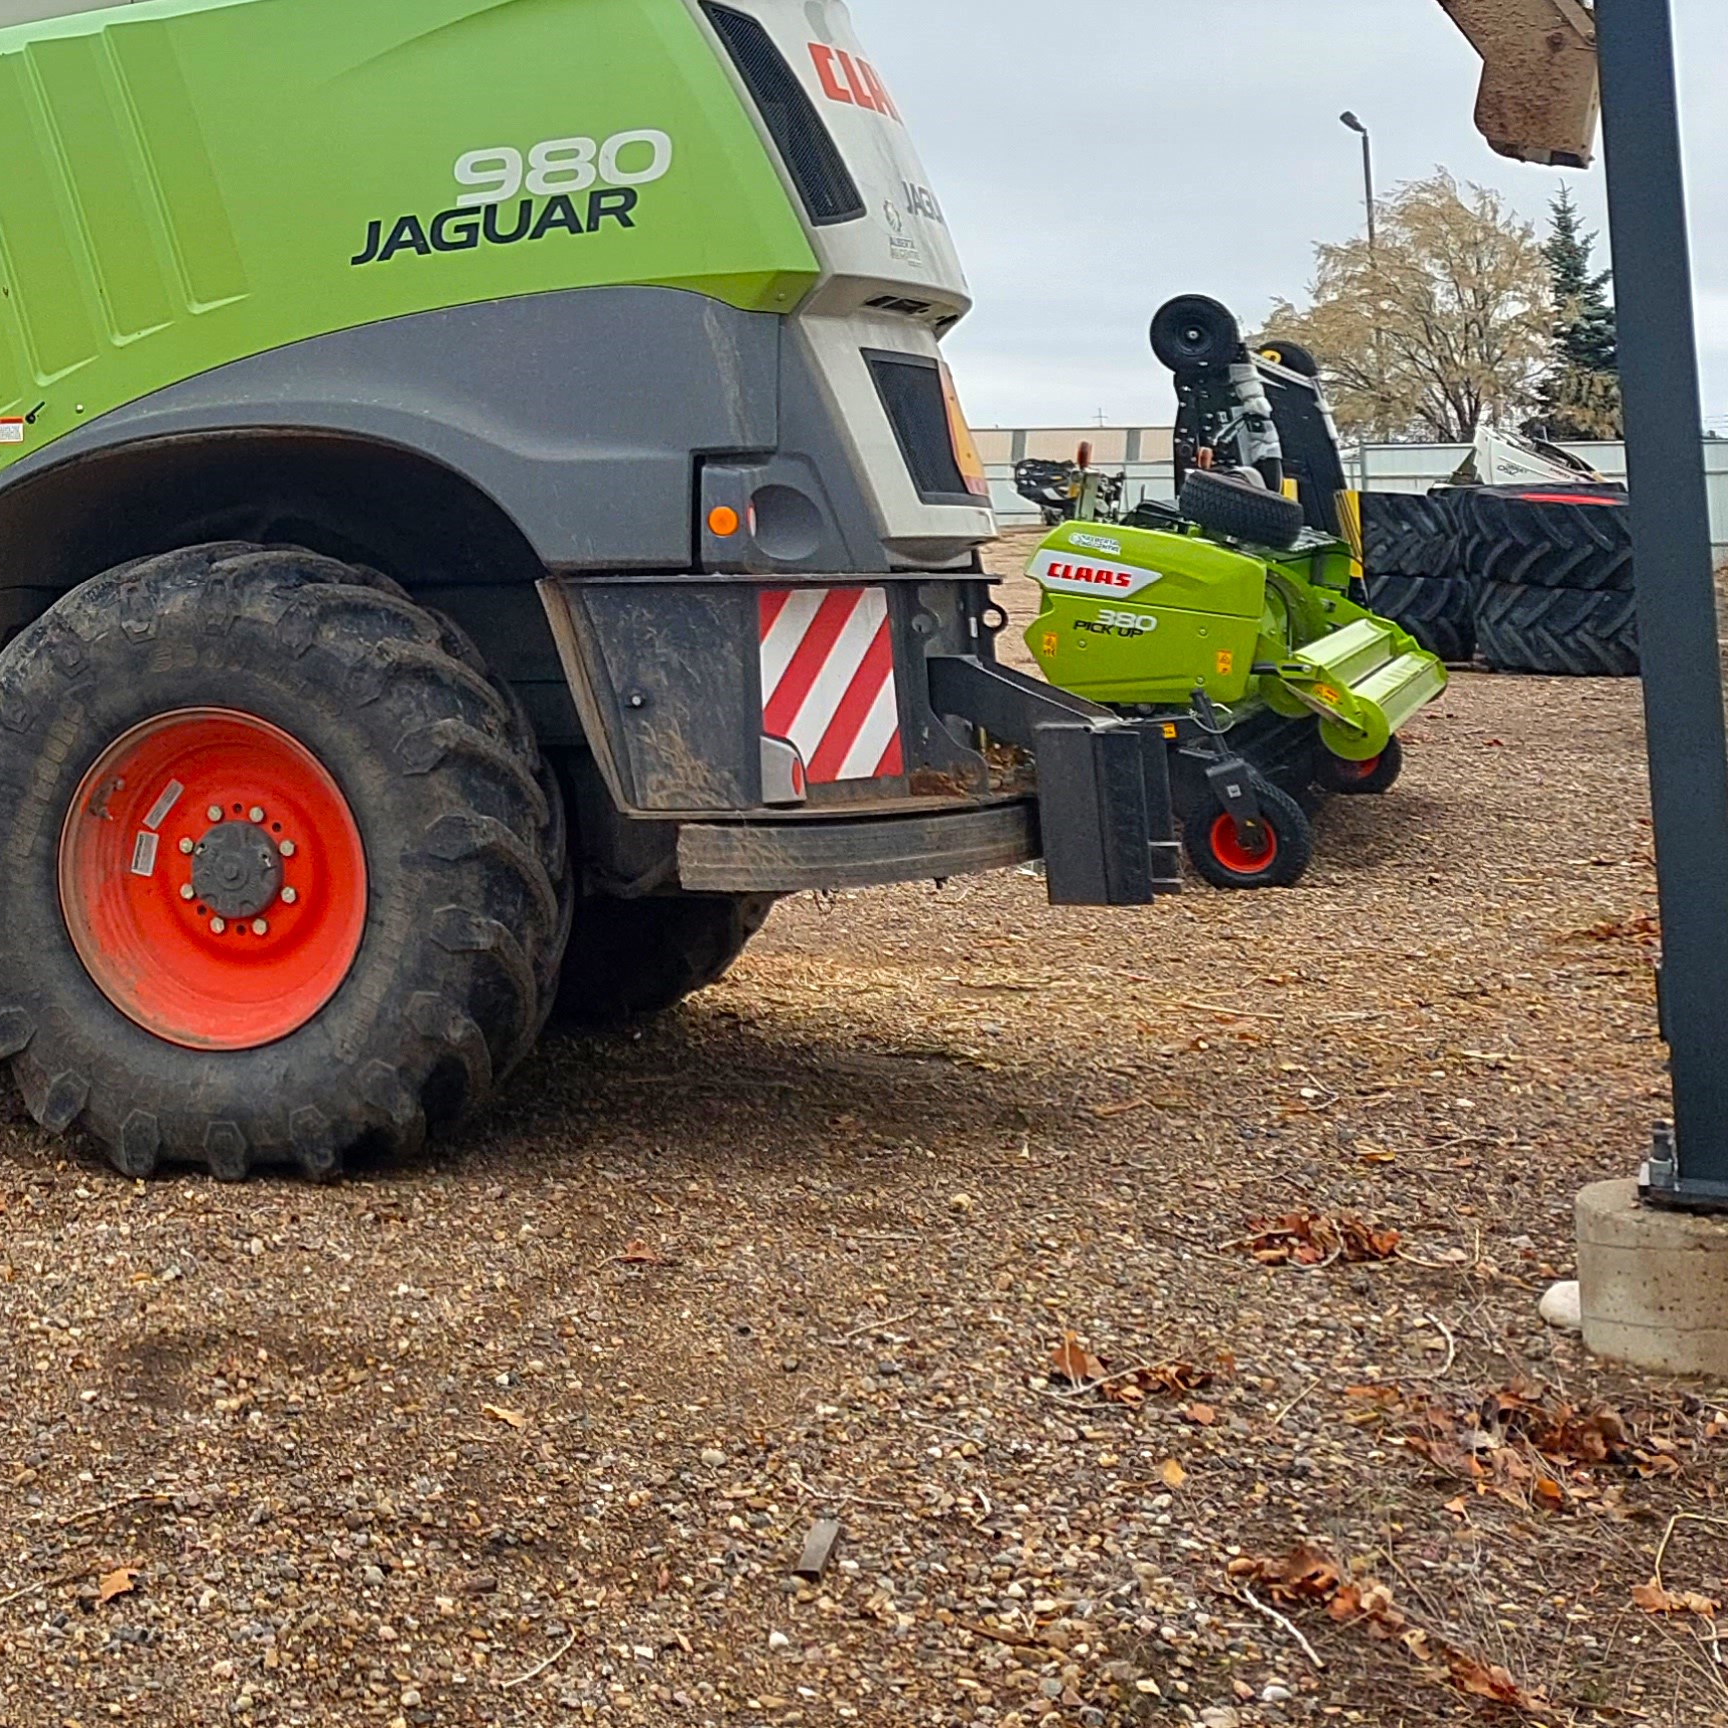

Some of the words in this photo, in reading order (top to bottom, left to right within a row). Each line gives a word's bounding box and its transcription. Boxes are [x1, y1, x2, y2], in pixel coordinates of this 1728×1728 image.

[807, 41, 904, 127] CLA
[454, 129, 672, 207] 980
[350, 186, 638, 266] JAGUAR
[1047, 562, 1132, 588] CLAAS
[1073, 620, 1114, 635] PICK
[1117, 627, 1144, 638] UP
[1098, 609, 1158, 632] 380
